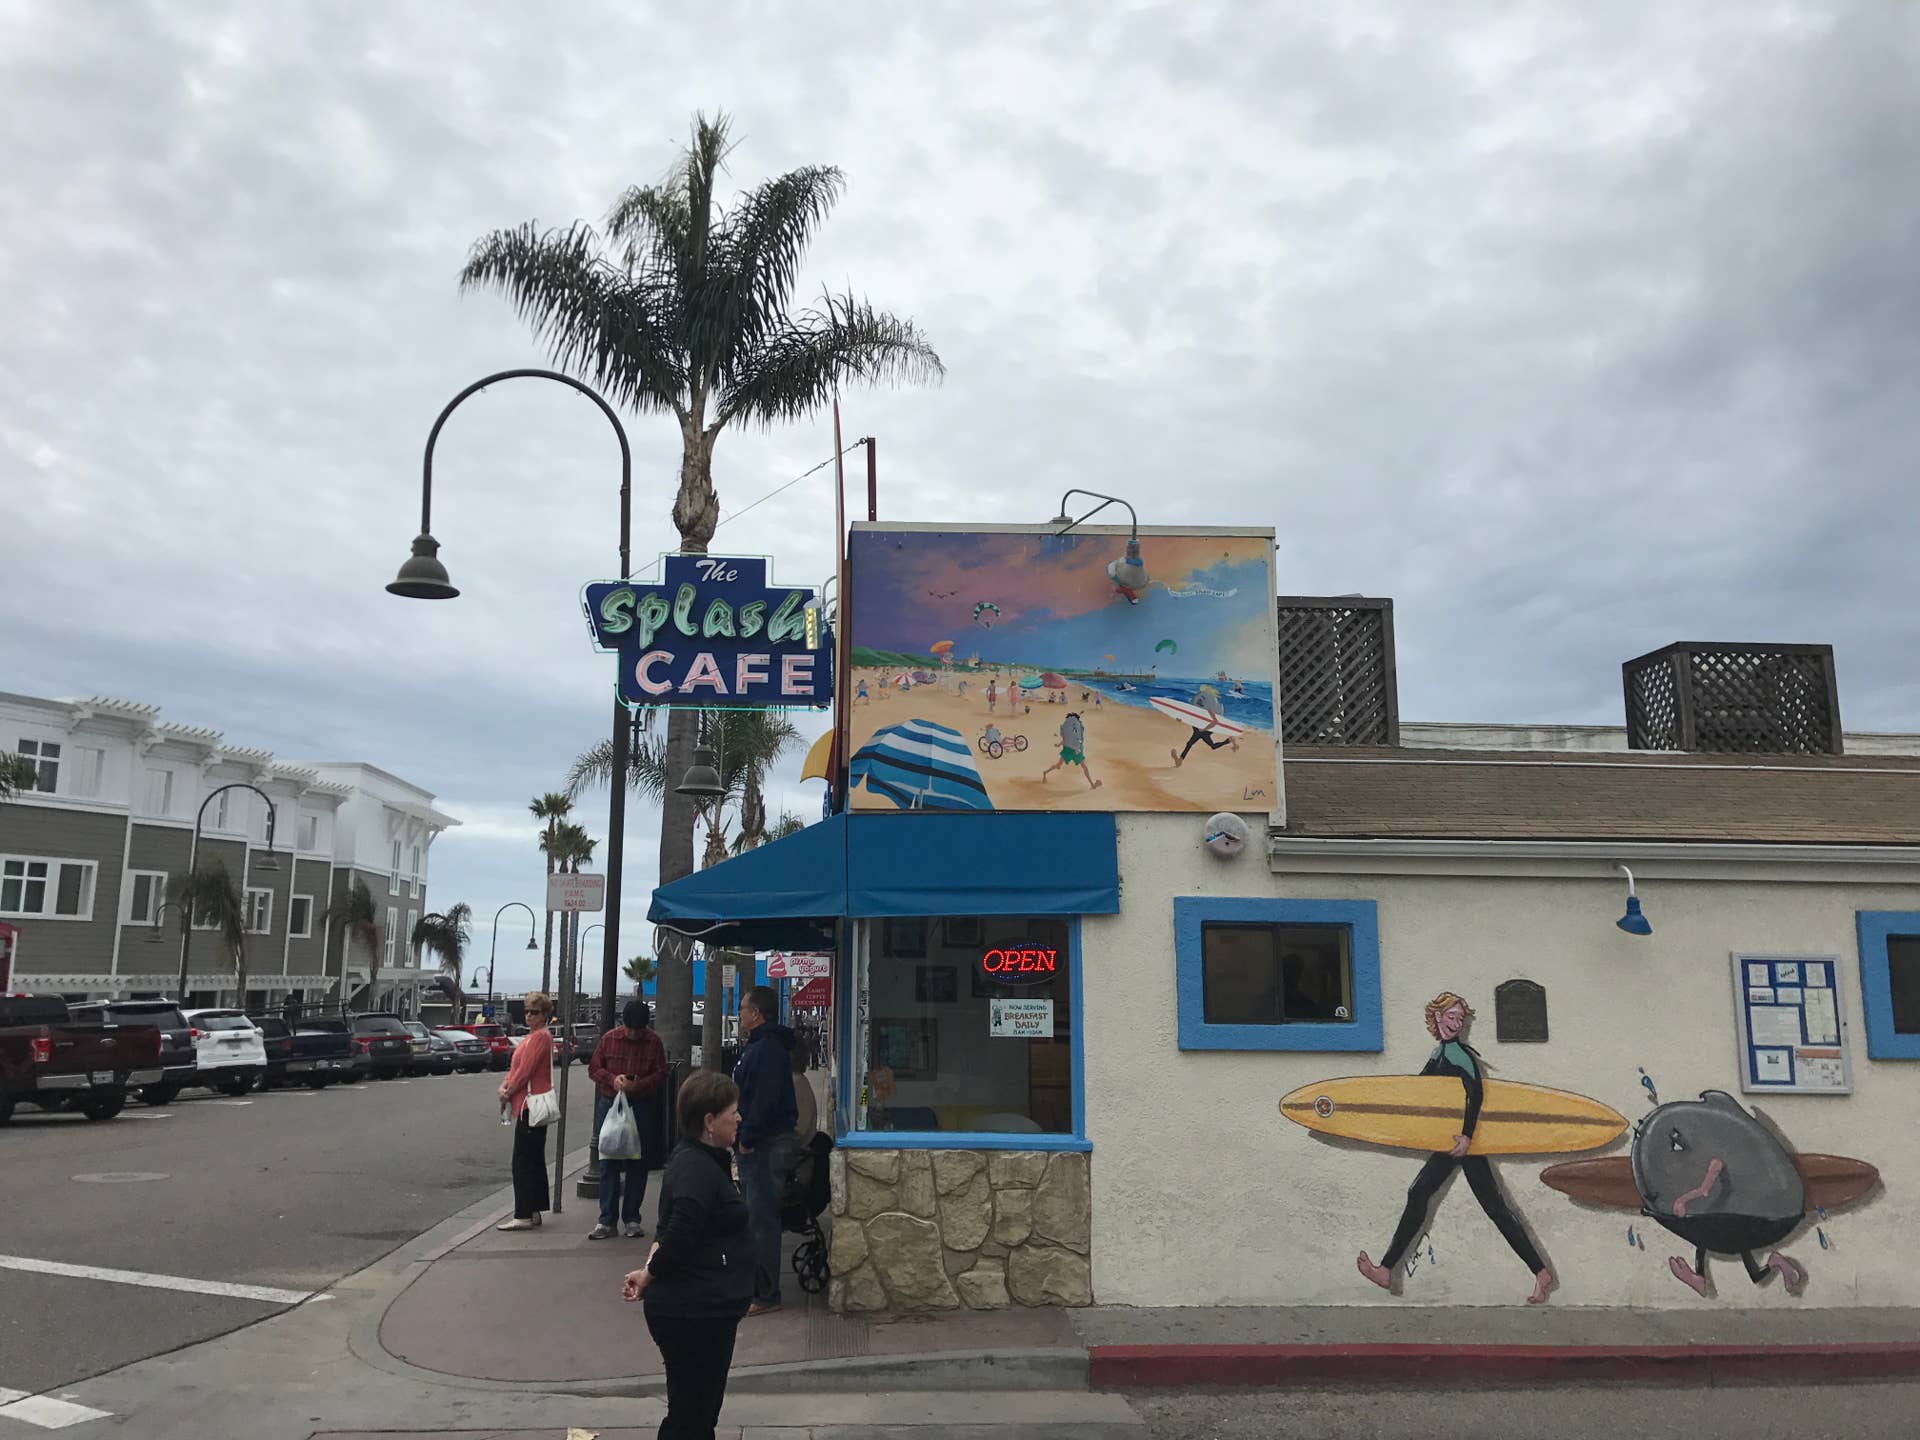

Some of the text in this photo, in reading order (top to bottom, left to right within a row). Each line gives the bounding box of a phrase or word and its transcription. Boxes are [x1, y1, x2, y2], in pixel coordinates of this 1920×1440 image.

[696, 559, 738, 582] The
[635, 650, 815, 696] CAFE
[790, 957, 816, 967] pismo
[983, 949, 1057, 972] OPEN
[799, 965, 828, 977] yogurt
[1004, 1012, 1049, 1021] BREAKFAST
[1015, 1021, 1040, 1029] DAILY
